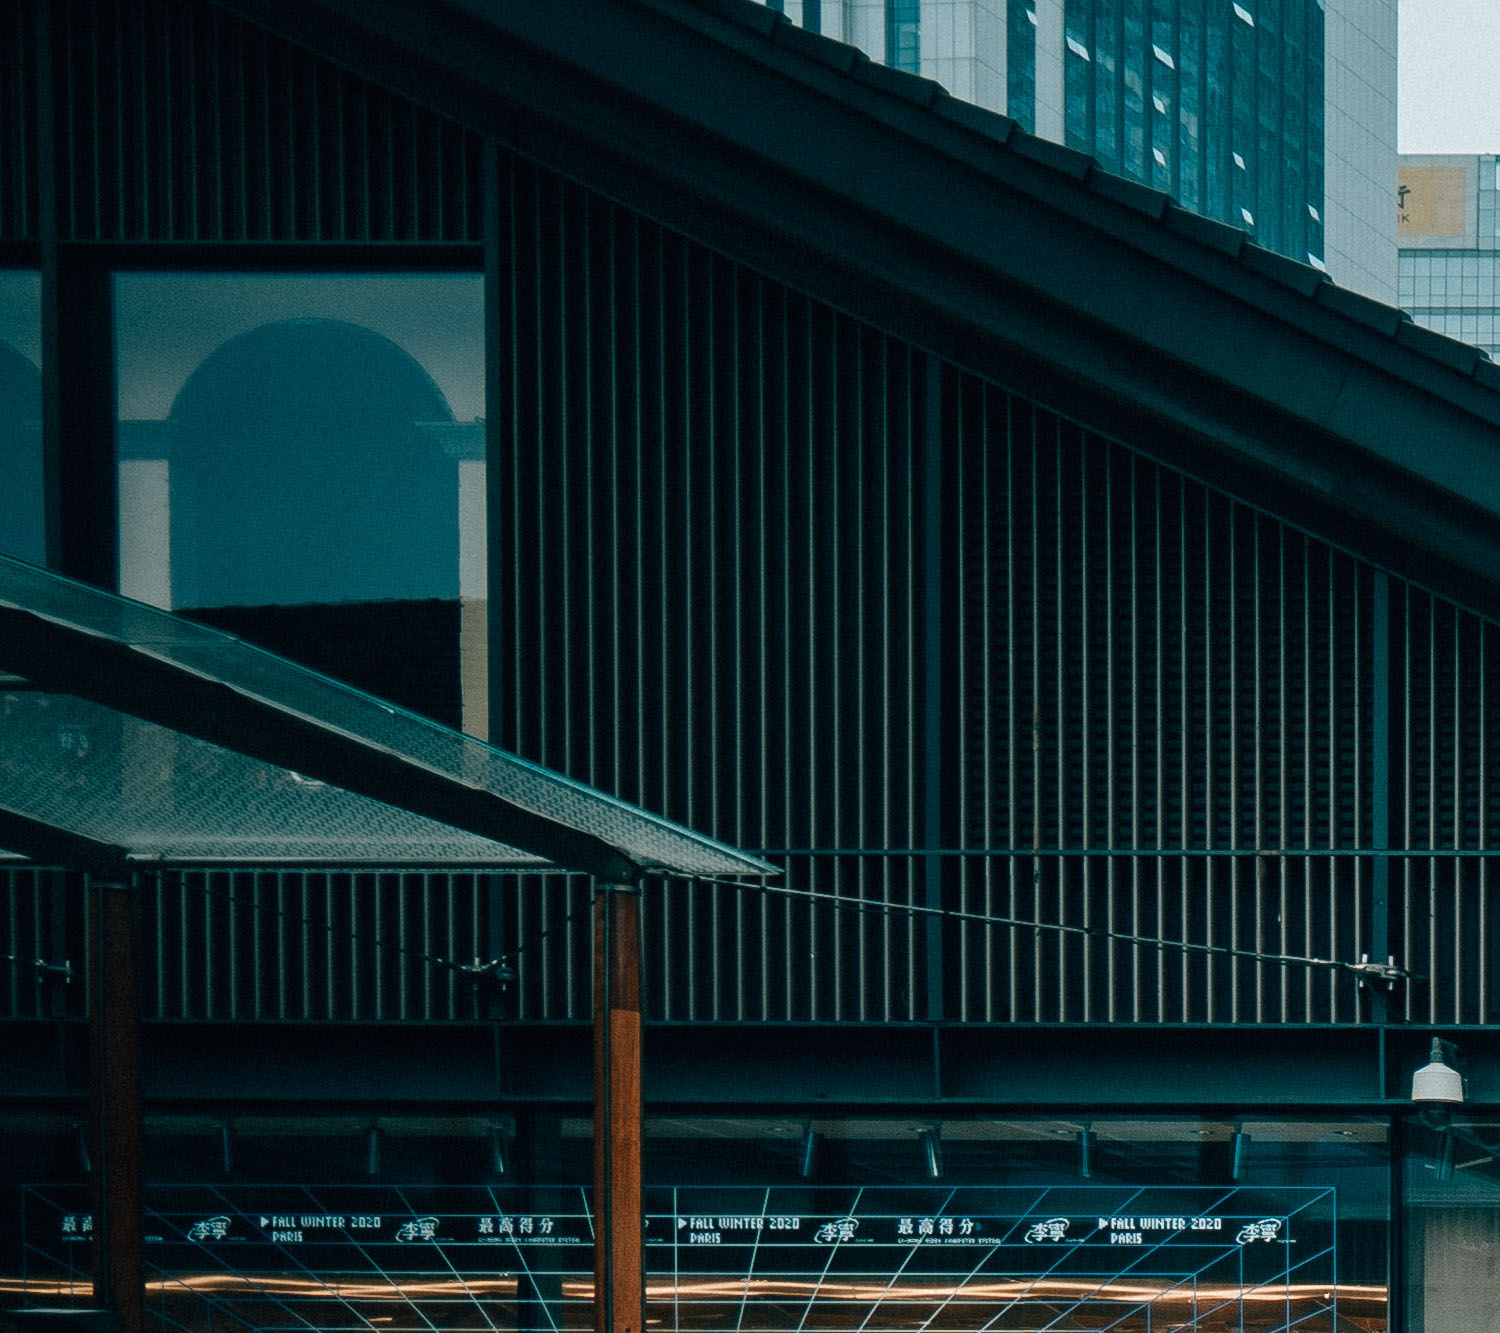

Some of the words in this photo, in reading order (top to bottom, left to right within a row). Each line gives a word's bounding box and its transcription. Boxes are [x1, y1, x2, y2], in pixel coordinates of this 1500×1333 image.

[272, 1216, 296, 1228] FALL
[301, 1216, 344, 1229] WINTER
[352, 1216, 381, 1229] 2020
[479, 1217, 553, 1234] 最高得分
[690, 1218, 714, 1230] FALL
[718, 1218, 764, 1230] WINTER
[769, 1218, 800, 1230] 2020
[898, 1218, 974, 1235] 最高得分
[1111, 1218, 1136, 1230] FALL
[1140, 1218, 1186, 1230] WINTER
[1191, 1218, 1221, 1230] 2020
[272, 1231, 303, 1243] PARIS
[690, 1232, 721, 1244] PARIS
[1111, 1233, 1142, 1245] PARIS
